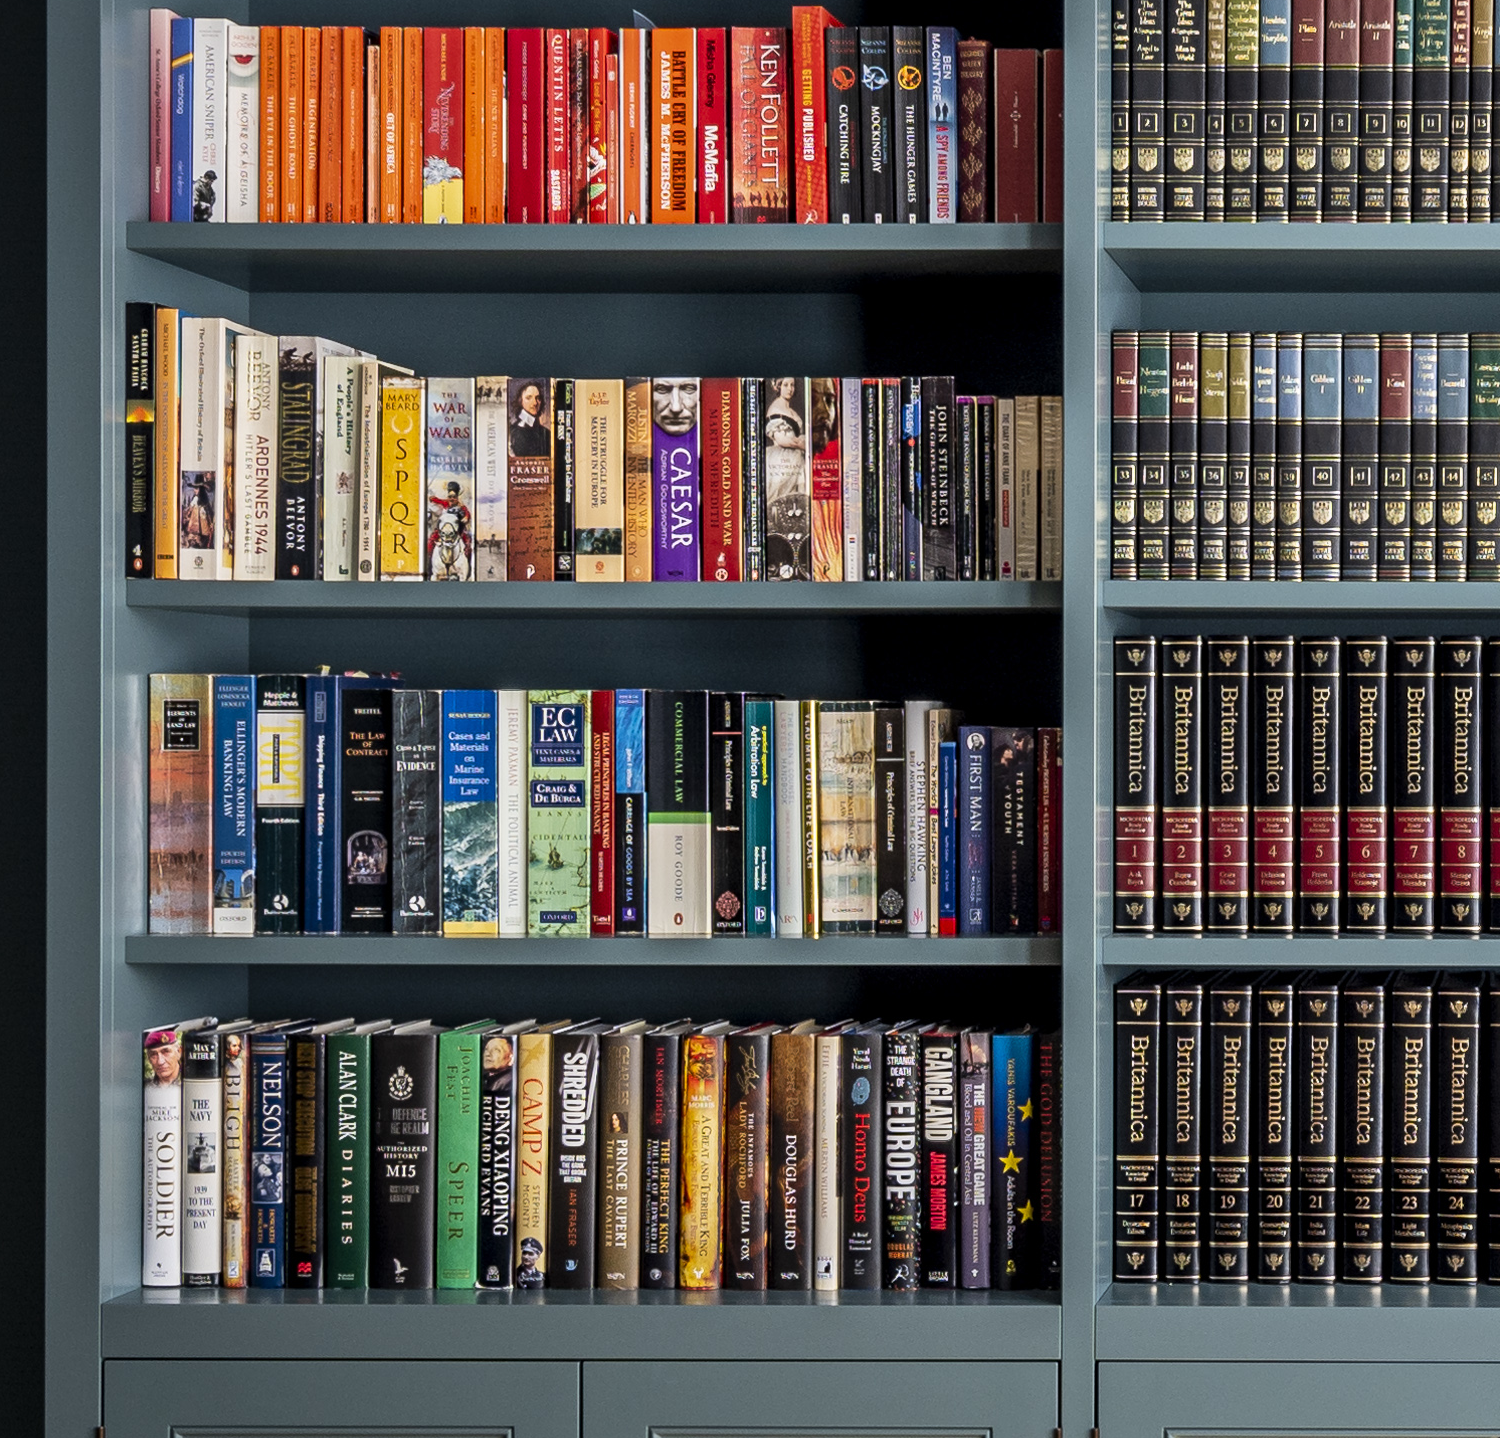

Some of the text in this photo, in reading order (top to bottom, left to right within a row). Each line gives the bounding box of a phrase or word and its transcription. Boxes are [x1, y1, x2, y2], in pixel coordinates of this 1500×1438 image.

[205, 45, 214, 140] AMERICAN SNIPER
[932, 33, 941, 101] MACINTYRE
[943, 56, 951, 79] BEN
[661, 51, 670, 210] JAMES M. McPHERSON
[672, 51, 686, 211] BATTLE CRY OF FREEDOM
[704, 126, 718, 192] McMafia
[760, 45, 780, 188] KEN FOLLETT
[839, 105, 849, 184] CATCHING FIRE
[872, 106, 881, 173] MOCKINGJAY
[281, 382, 313, 483] STALINGRAD
[386, 394, 418, 402] MARY
[386, 403, 419, 411] BEARD
[255, 435, 269, 555] ARDENNES 1944
[670, 447, 693, 549] CAESAR
[937, 405, 948, 526] JOHN STEINBECK
[286, 499, 295, 550] BEEVOR
[296, 497, 305, 552] ANTONY
[260, 719, 301, 798] TORT
[540, 707, 576, 727] EC
[540, 728, 577, 742] LAW
[750, 726, 760, 798] Arbitration Law
[1129, 685, 1147, 794] Britannica
[1175, 686, 1193, 795] Britannica
[1221, 685, 1239, 794] Britannica
[224, 739, 233, 818] BANKING LAW
[236, 720, 246, 836] ELLINGER'S MODERN
[507, 708, 519, 907] JEREMY PAXMAN THE POLITICAL ANIMAL
[674, 702, 683, 902] COMMERCIAL LAW ROY GOODE
[917, 761, 926, 872] STEPHEN HAWKING
[970, 755, 982, 831] FIRST MAN
[1177, 846, 1186, 858] 2
[225, 1075, 241, 1150] BLIGH
[262, 1062, 281, 1147] NELSON
[521, 1078, 543, 1176] CAMP Z
[562, 1052, 587, 1146] SHREDDED
[925, 1047, 952, 1229] GANGLAND JAMES MORTON
[1131, 1035, 1149, 1143] Britannica
[1177, 1036, 1195, 1144] Britannica
[1223, 1035, 1242, 1145] Britannica
[156, 1132, 175, 1240] SOLDIER
[338, 1051, 357, 1245] ALAN CLARK DIARIES
[493, 1096, 510, 1236] DENG XIAOPING
[615, 1139, 628, 1249] PRINCE RUPERT
[785, 1135, 796, 1250] DOUGLAS HURD
[855, 1113, 869, 1222] Homo Deus
[887, 1101, 915, 1200] EUROPE
[448, 1161, 469, 1241] SPEER
[1130, 1195, 1144, 1207] 17
[1221, 1196, 1235, 1209] 19
[1267, 1196, 1283, 1208] 20
